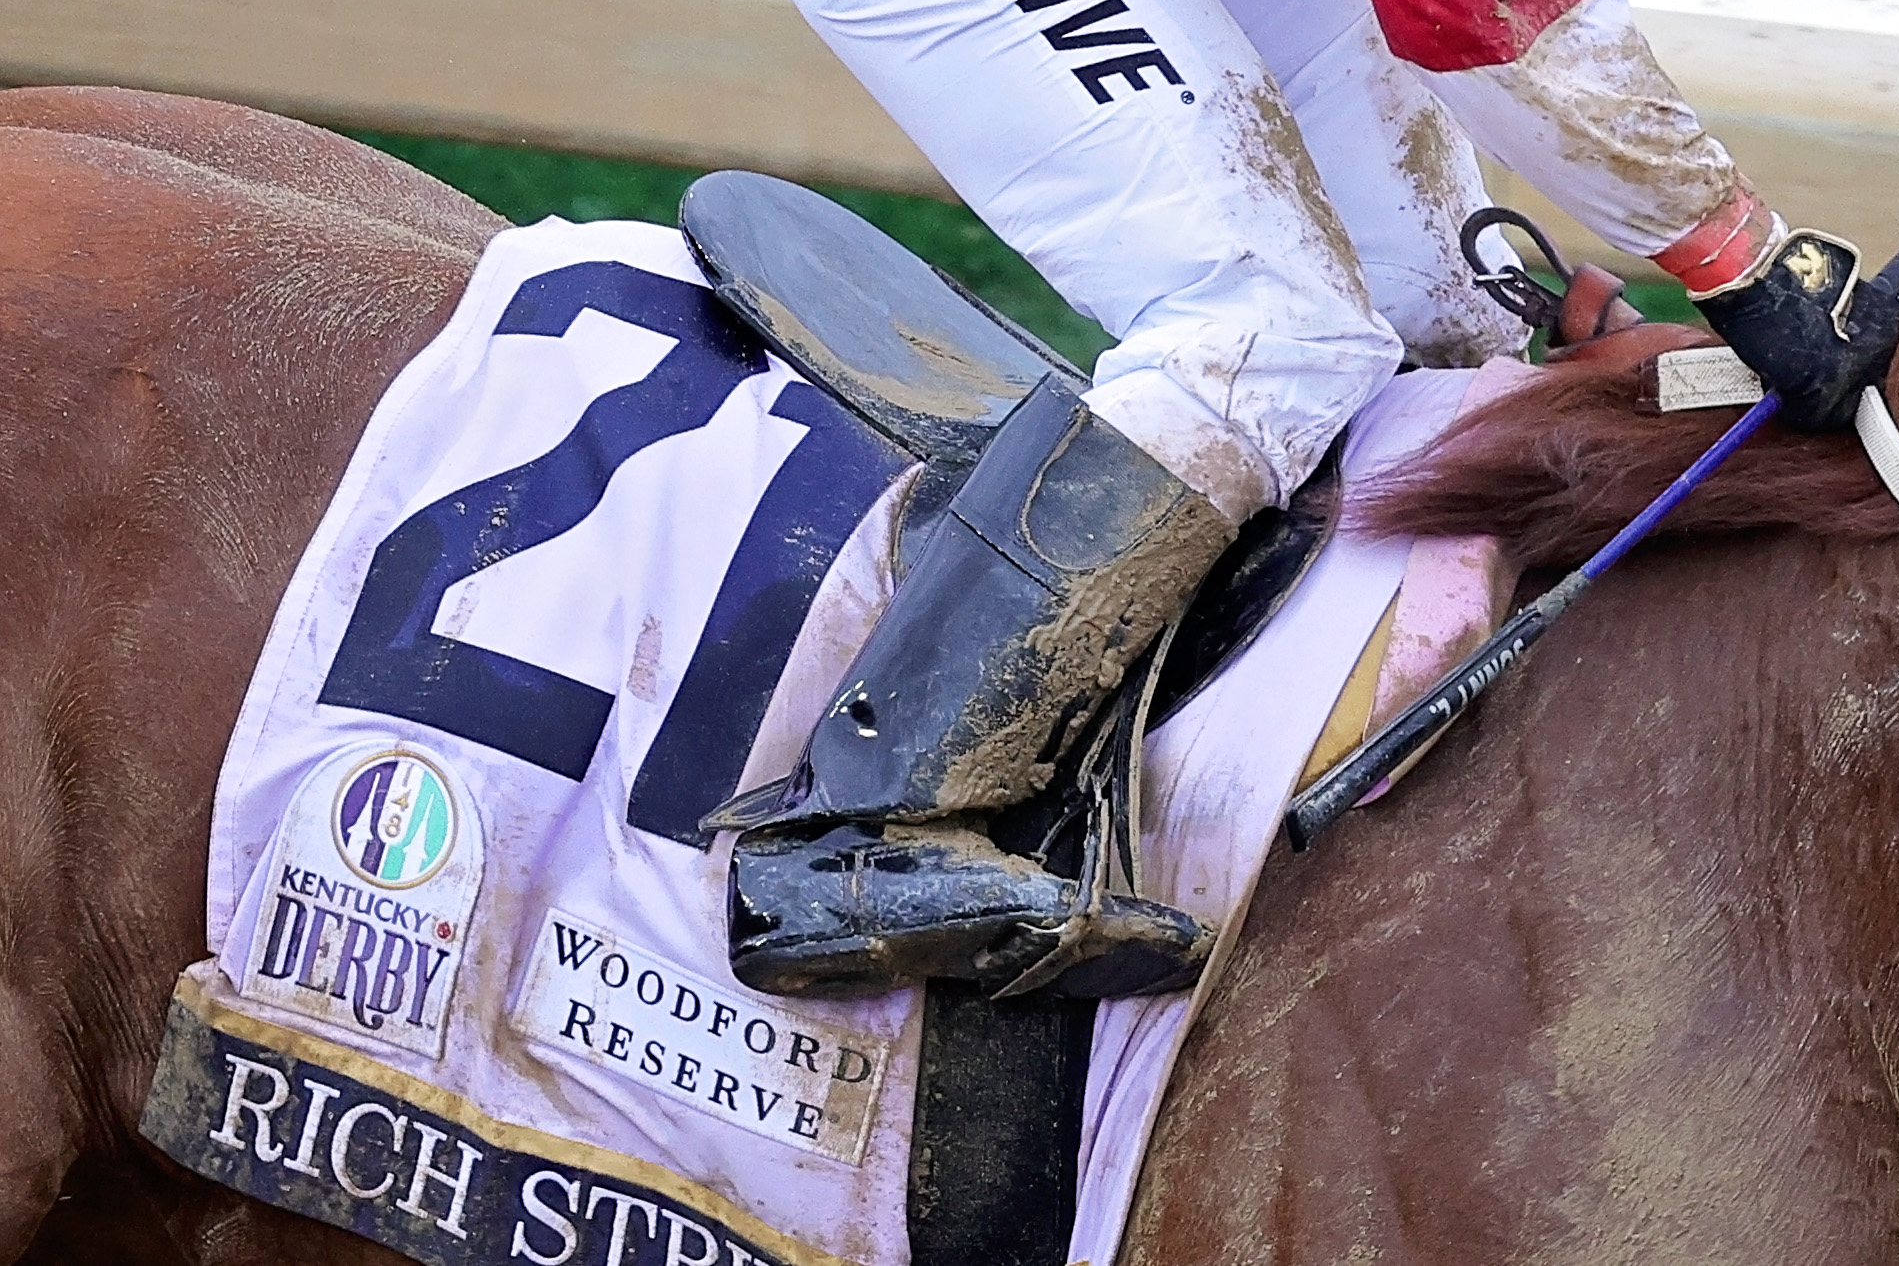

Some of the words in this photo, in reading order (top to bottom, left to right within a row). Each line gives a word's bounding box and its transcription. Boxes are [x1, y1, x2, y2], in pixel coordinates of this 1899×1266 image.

[316, 259, 928, 853] 21
[257, 892, 451, 1031] DERBY
[280, 863, 431, 933] KENTUCKY
[553, 921, 873, 1084] WOODFORD
[559, 998, 824, 1140] RESERVE
[208, 1051, 484, 1241] RICH
[510, 1169, 770, 1266] STR
